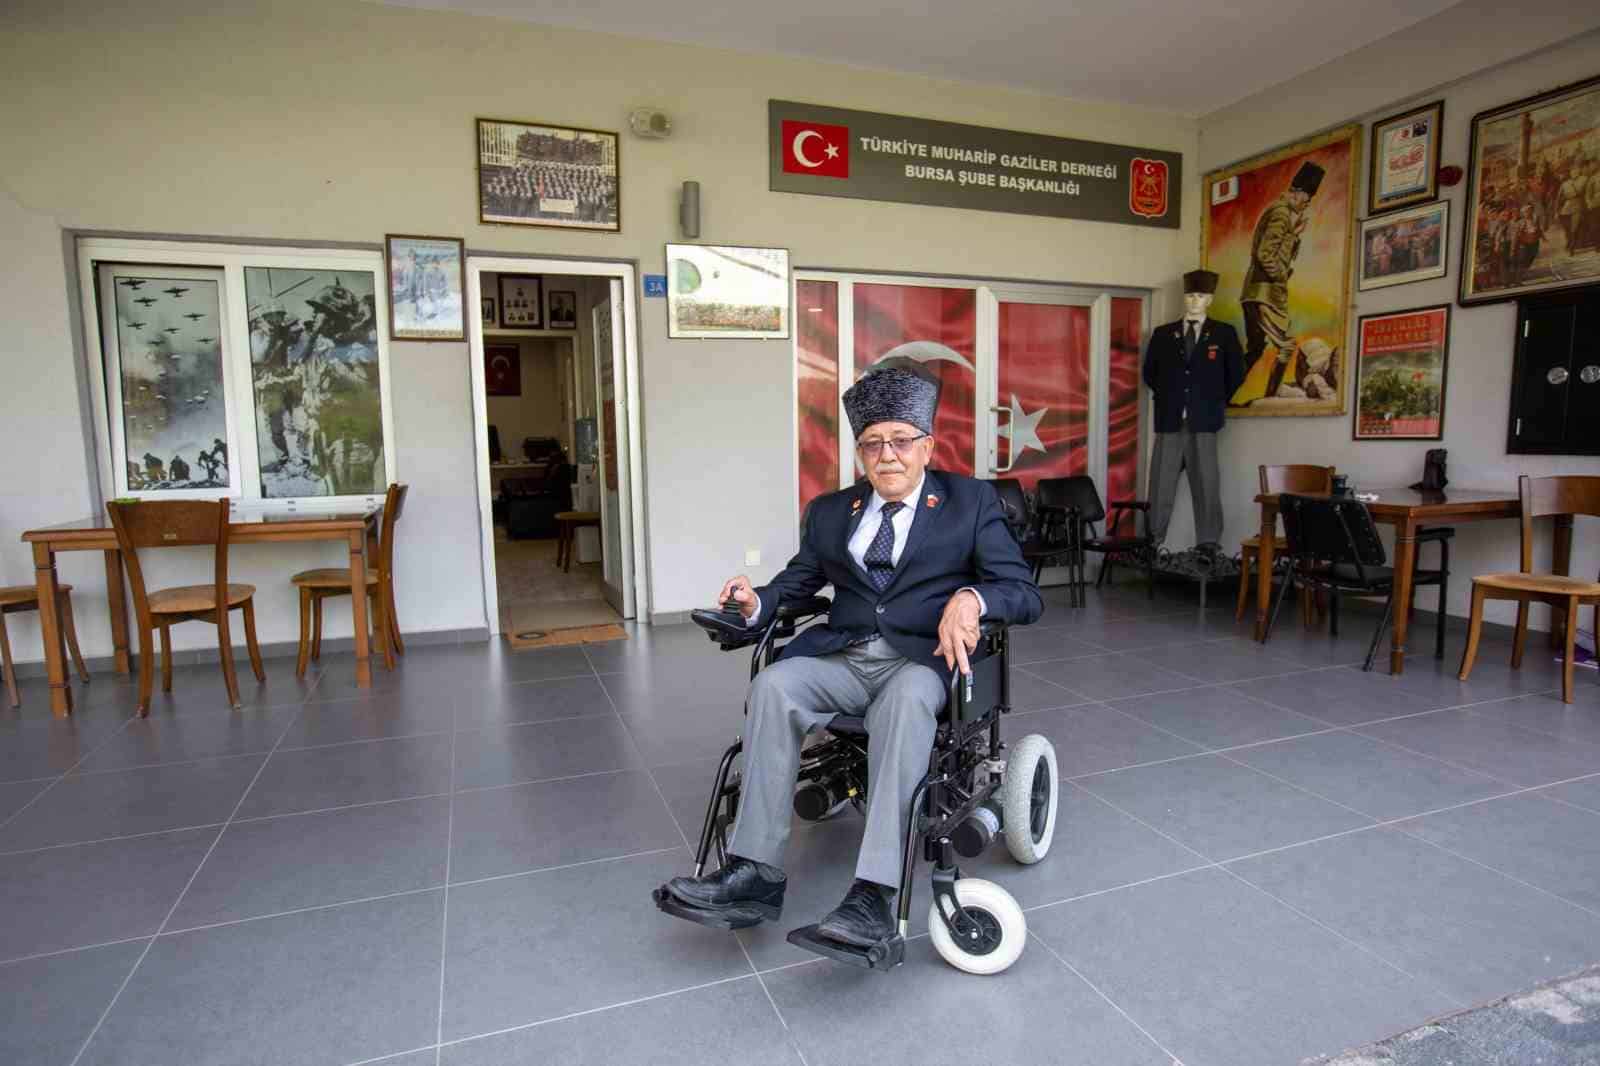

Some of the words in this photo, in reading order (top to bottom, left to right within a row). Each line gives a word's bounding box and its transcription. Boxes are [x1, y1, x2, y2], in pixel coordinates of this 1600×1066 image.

[860, 136, 927, 157] TÜRKİYE
[931, 145, 997, 165] MUHARİP
[1000, 154, 1057, 173] GAZİLER
[1061, 161, 1117, 179] DERNEĞİ
[905, 164, 955, 182] BURSA
[958, 170, 996, 187] ŞUBE
[999, 175, 1080, 196] BAŞKANLIĞI
